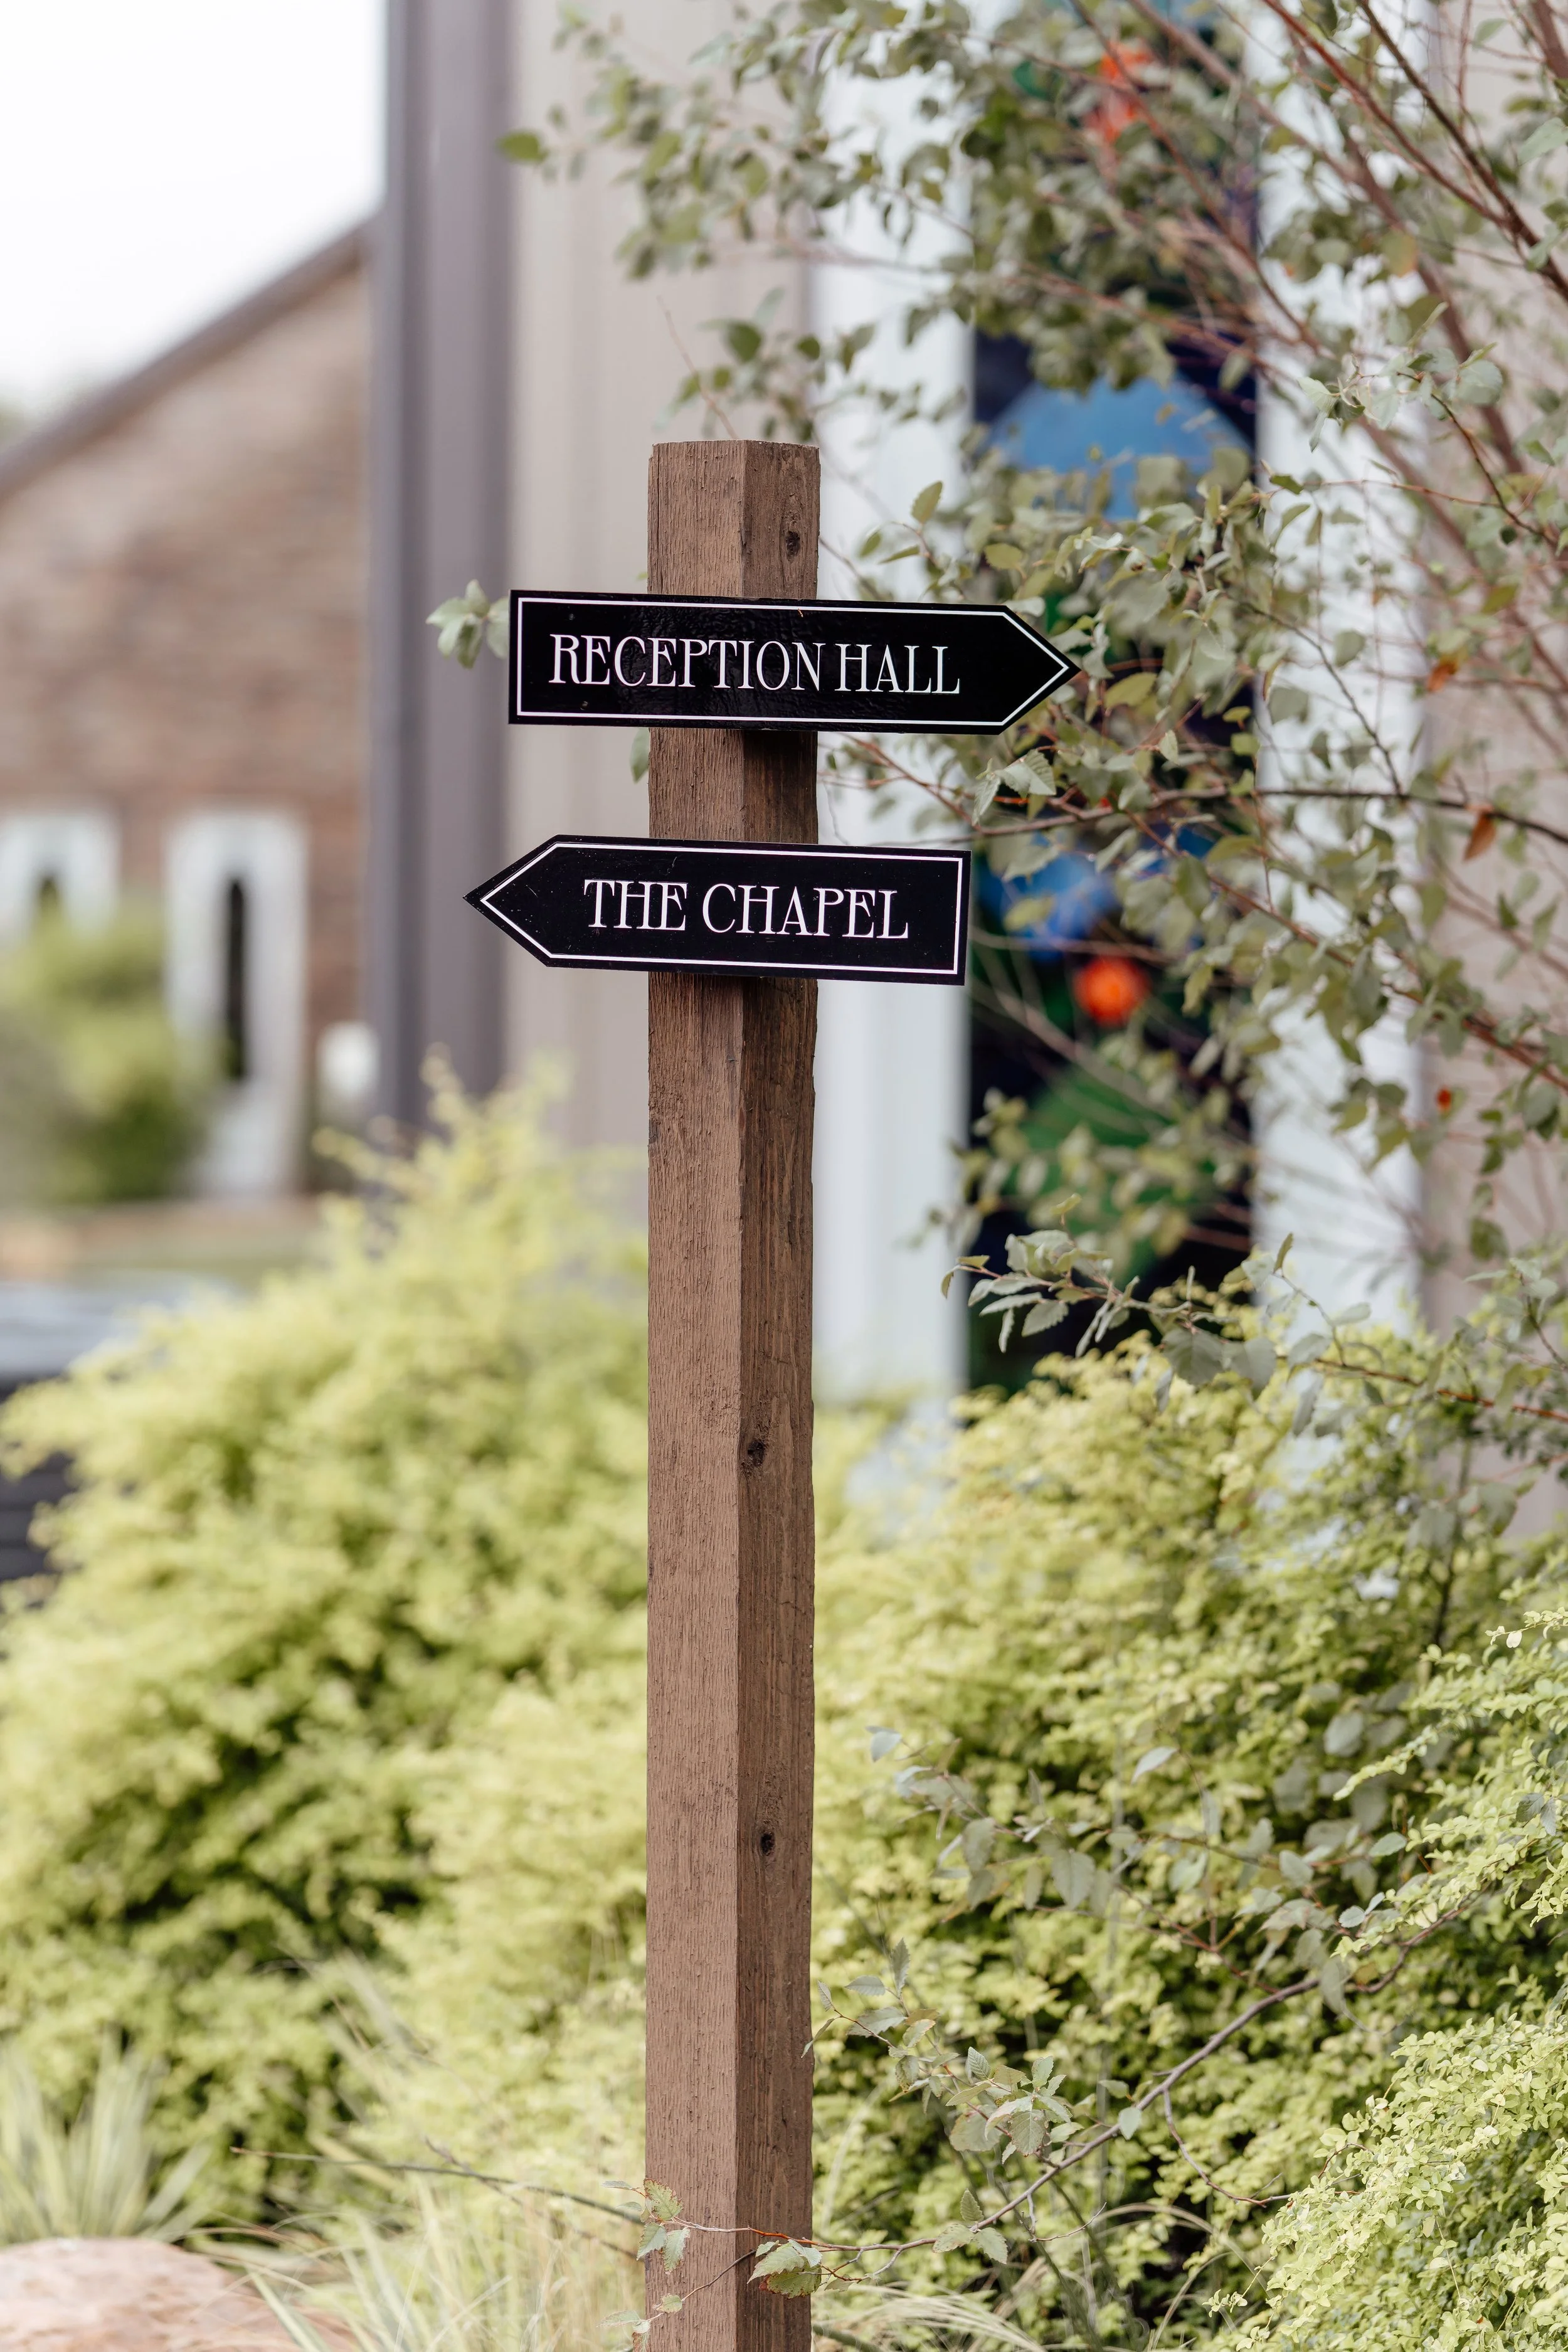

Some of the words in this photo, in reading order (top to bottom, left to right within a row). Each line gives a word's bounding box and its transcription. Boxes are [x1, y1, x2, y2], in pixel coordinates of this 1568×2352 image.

[548, 633, 825, 691] RECEPTION
[834, 643, 960, 694] HALL
[583, 879, 688, 931] THE
[702, 883, 909, 939] CHAPEL
